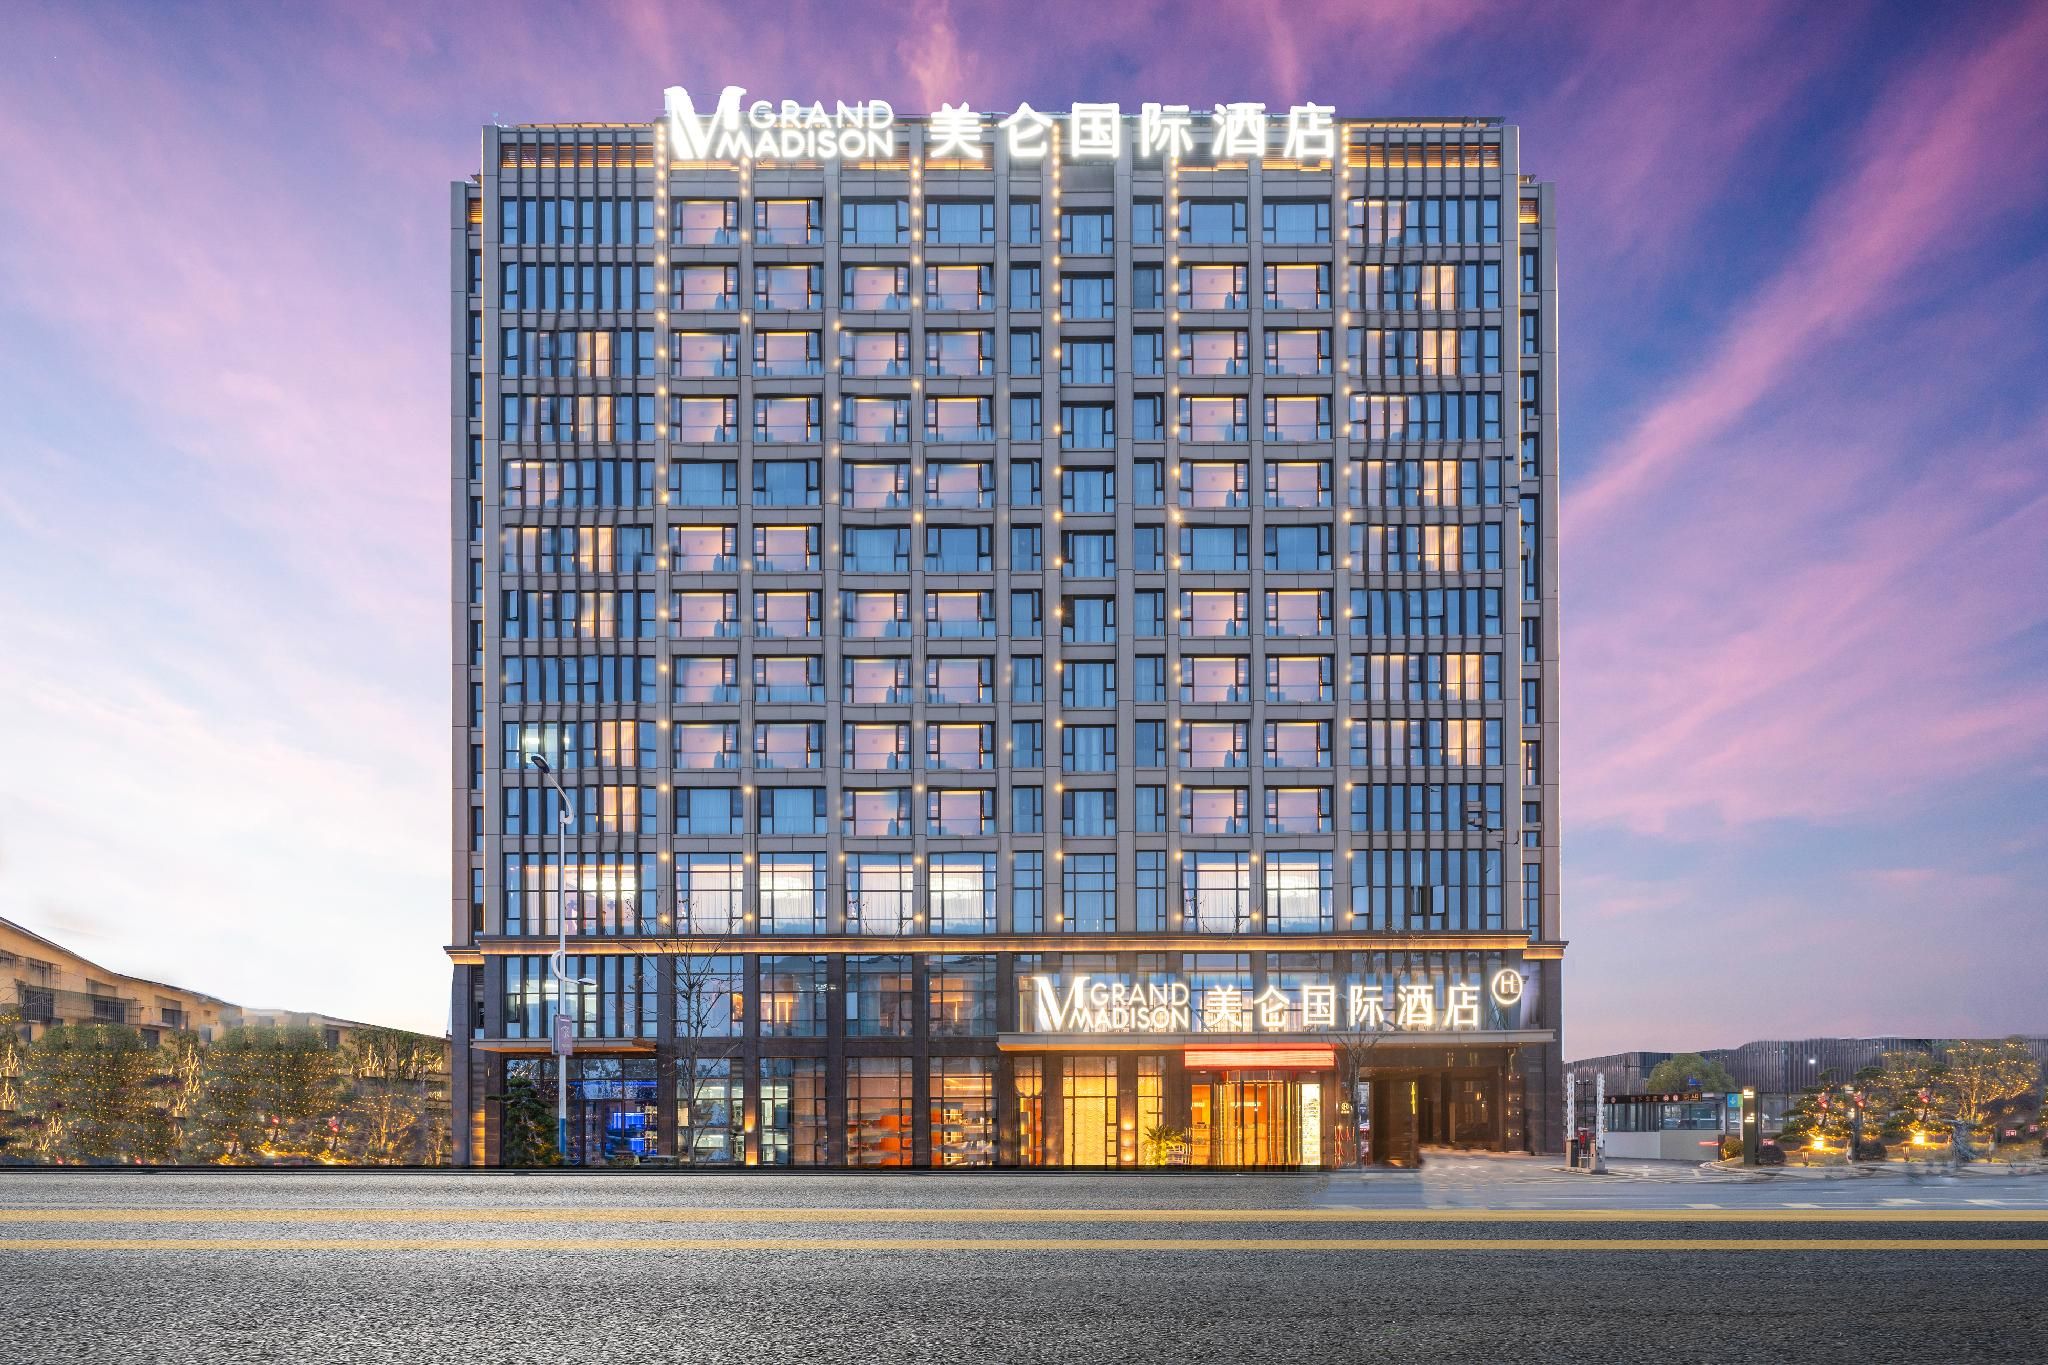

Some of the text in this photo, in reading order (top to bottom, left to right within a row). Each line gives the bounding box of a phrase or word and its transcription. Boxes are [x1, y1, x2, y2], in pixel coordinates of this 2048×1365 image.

[749, 100, 894, 128] GRAND
[716, 130, 893, 158] MADISON
[929, 102, 1336, 158] 美仑国际酒店
[1091, 983, 1189, 1005] GRAND
[1206, 984, 1481, 1027] 美仑国际酒店
[1069, 1007, 1189, 1029] MADISON
